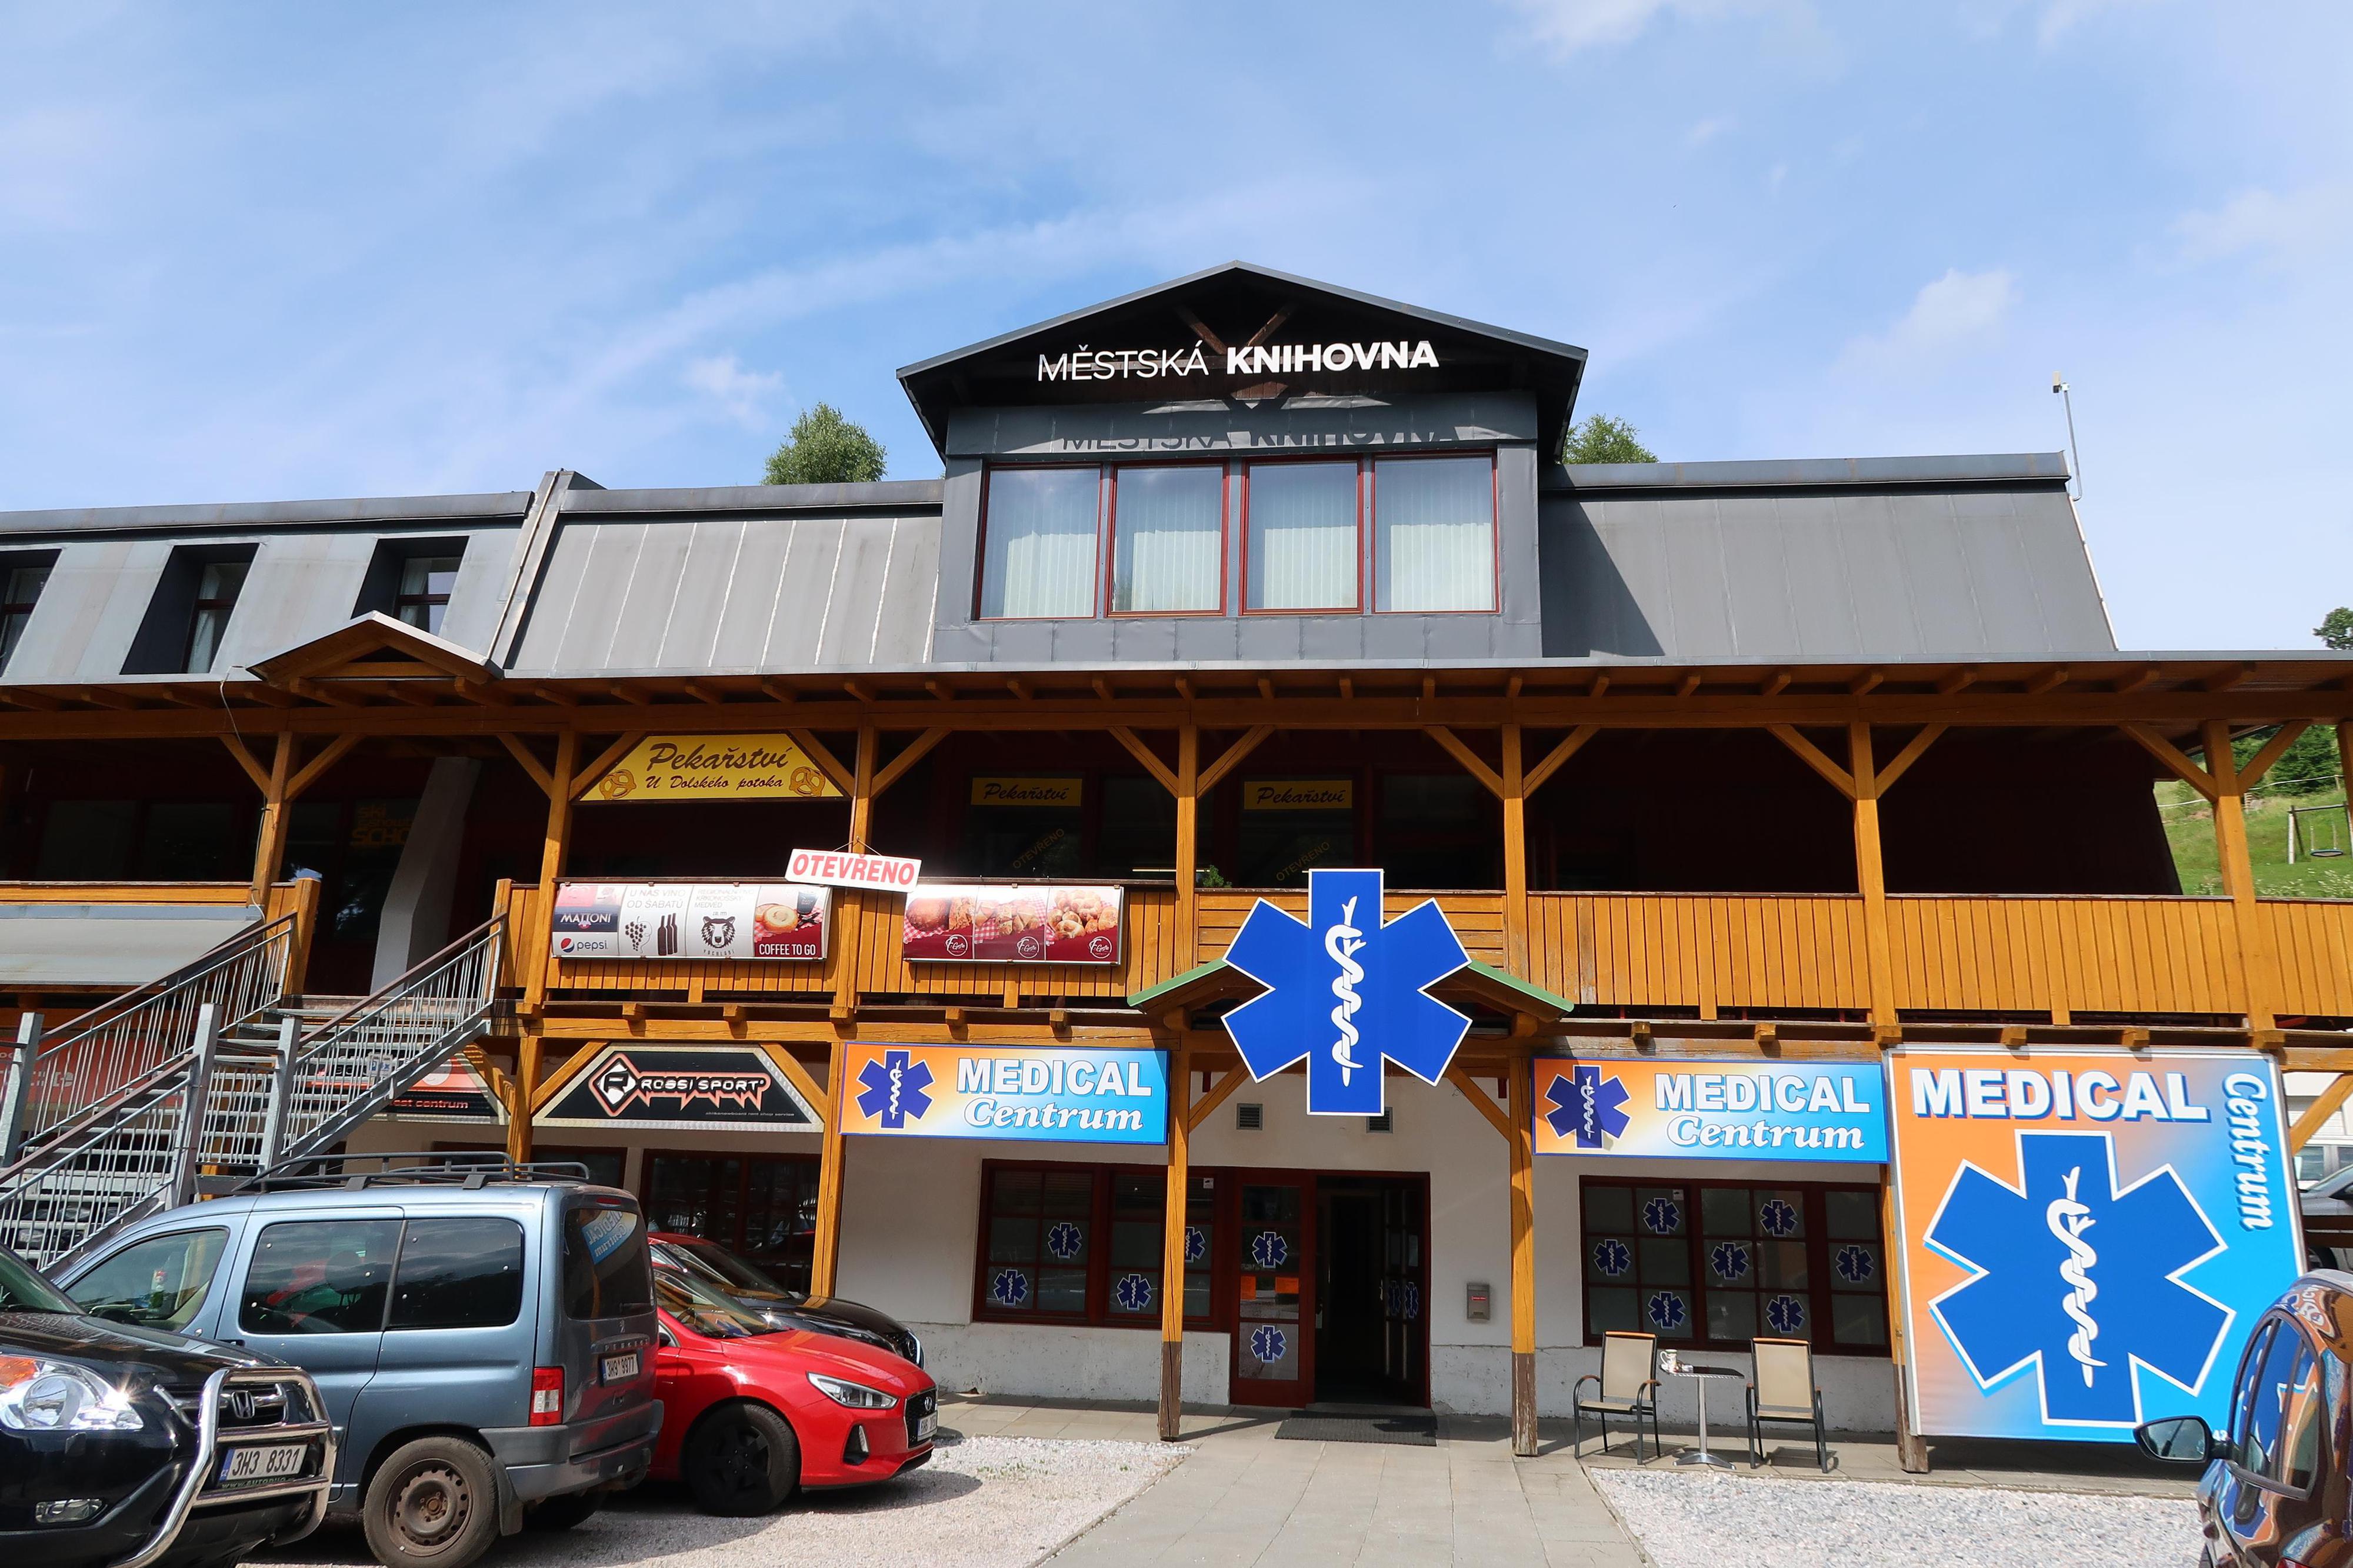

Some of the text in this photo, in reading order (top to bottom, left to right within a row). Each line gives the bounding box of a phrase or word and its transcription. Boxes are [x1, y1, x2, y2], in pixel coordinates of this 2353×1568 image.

[1038, 339, 1440, 382] MĚSTSKÁ KNIHOVNA
[648, 743, 793, 772] Pekařství
[645, 774, 784, 790] U Dolského potoka
[983, 783, 1069, 800] Pekařství
[1257, 787, 1347, 805] Pekařství
[793, 854, 915, 885] OTEVŘENO
[560, 913, 611, 923] MATTONI
[626, 900, 643, 909] OD
[576, 940, 608, 952] pepsi
[759, 943, 816, 956] COFFEE TO GO
[641, 1078, 759, 1091] ROSSI SPORT
[956, 1057, 1153, 1097] MEDICAL
[415, 1100, 469, 1108] centrum
[1654, 1073, 1871, 1114] MEDICAL
[1910, 1067, 2211, 1123] MEDICAL
[964, 1097, 1144, 1130] Centrum
[1666, 1115, 1865, 1149] Centrum
[2222, 1072, 2274, 1232] Centrum
[232, 1448, 300, 1476] 3H3 8331
